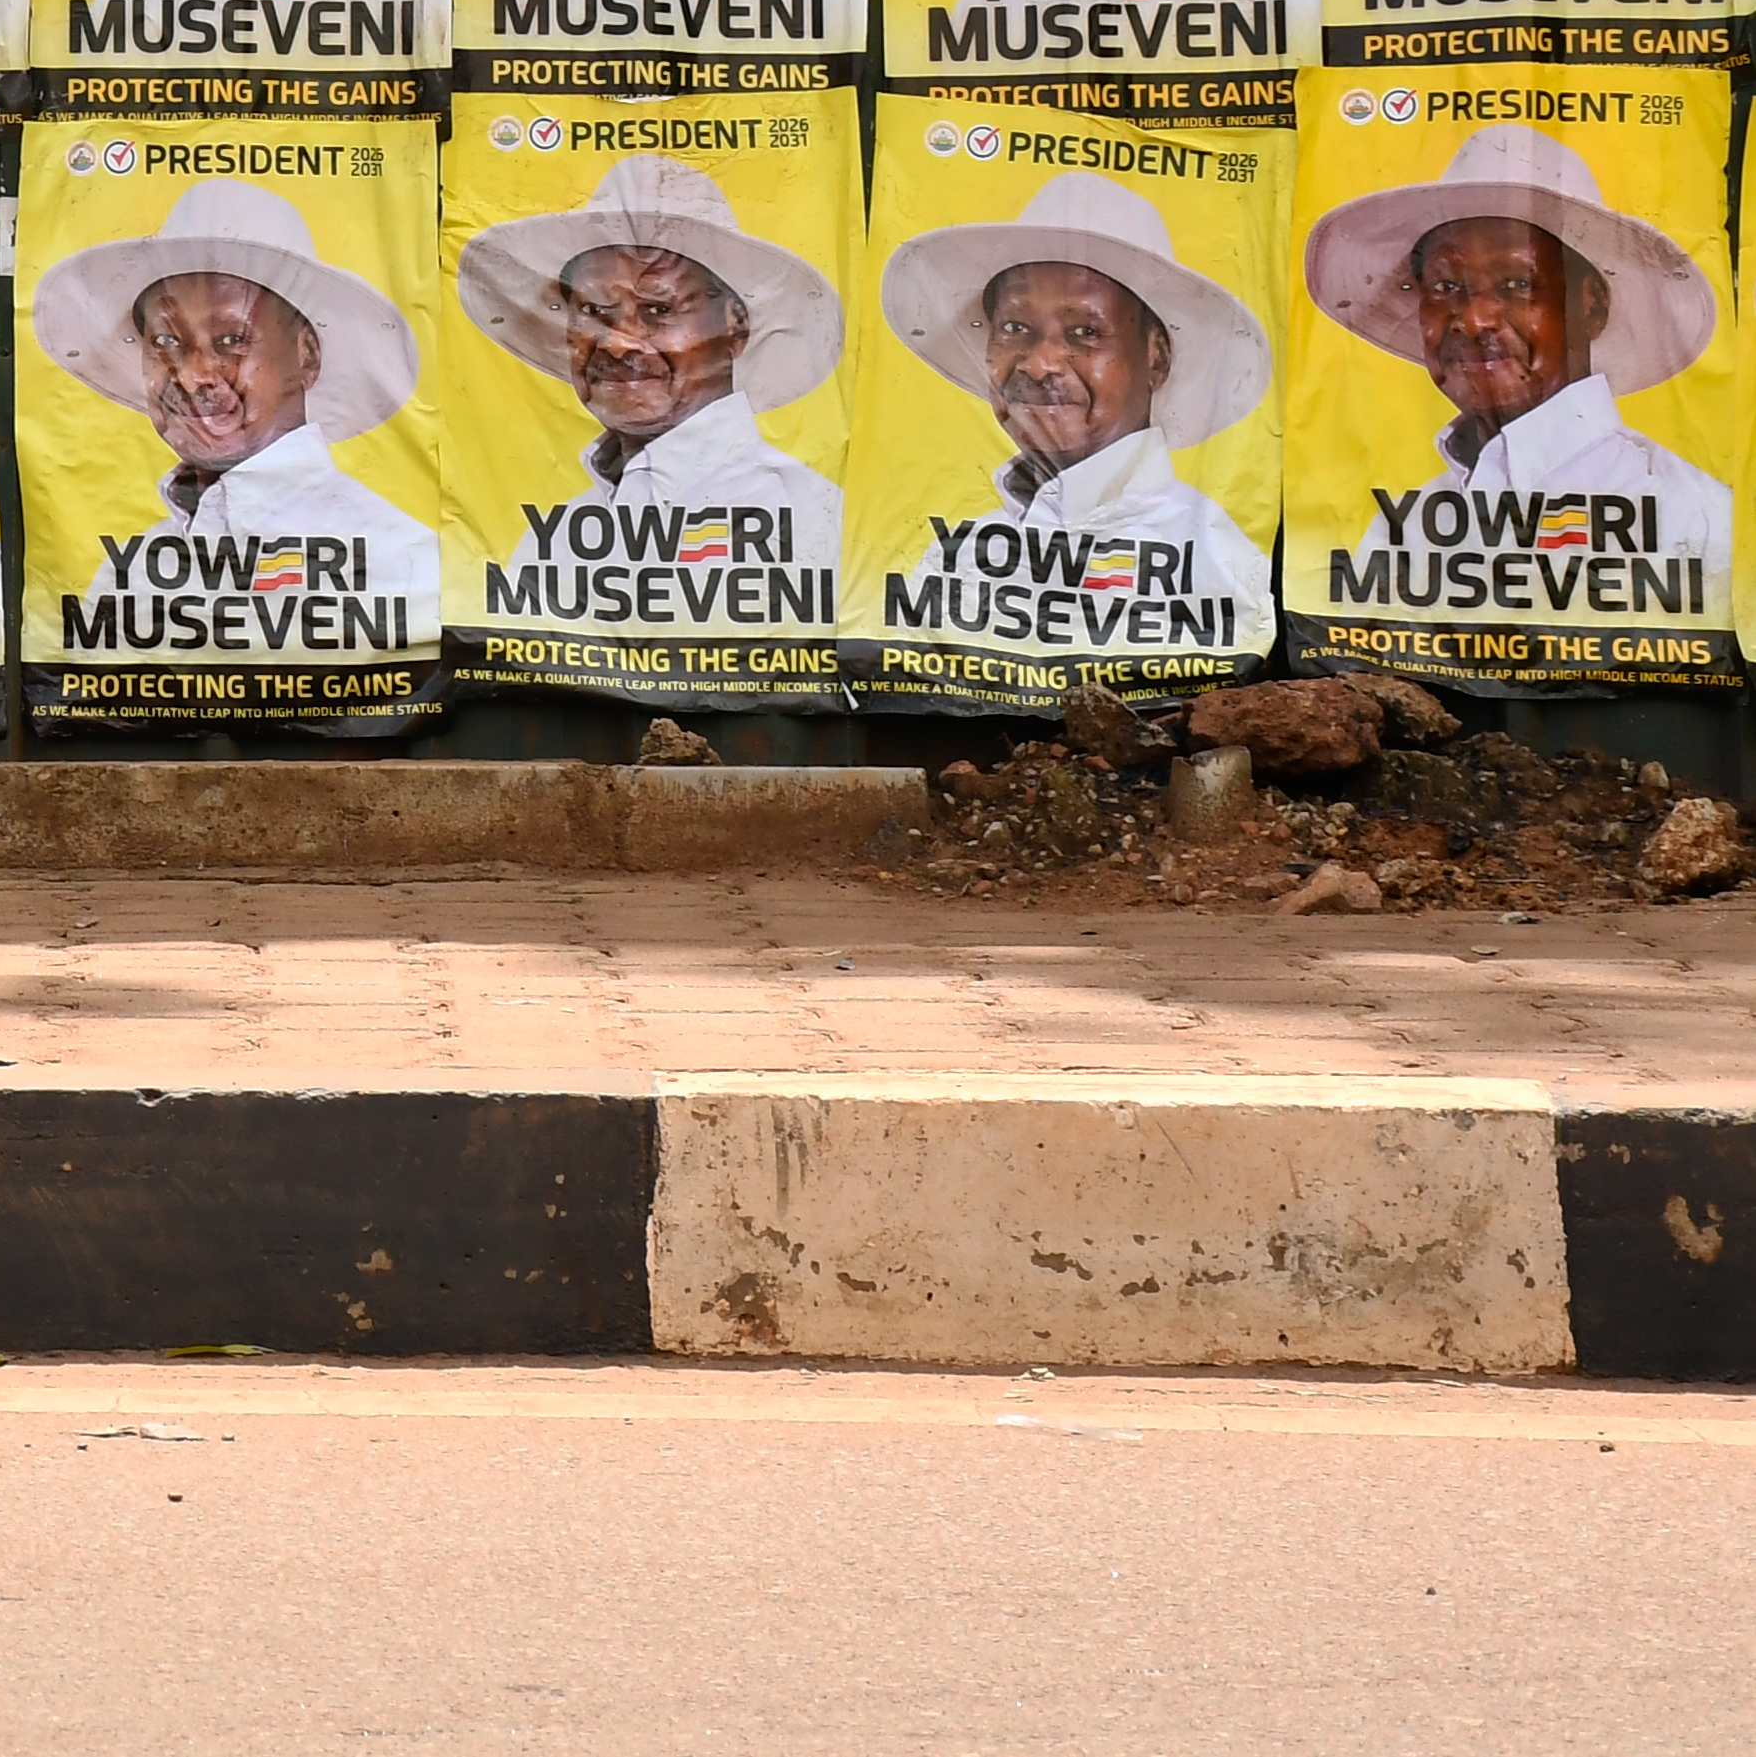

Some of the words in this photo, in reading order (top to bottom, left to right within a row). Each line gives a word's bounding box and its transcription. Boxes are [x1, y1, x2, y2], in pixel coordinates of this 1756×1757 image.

[70, 0, 413, 55] MUSEVENI
[929, 0, 1286, 61] MUSEVENI
[68, 79, 245, 103] PROTECTING
[261, 80, 319, 104] THE
[329, 81, 415, 105] GAINS
[1428, 90, 1633, 122] PRESIDENT
[572, 119, 762, 150] PRESIDENT
[1009, 132, 1213, 178] PRESIDENT
[146, 144, 344, 175] PRESIDENT
[487, 563, 833, 623] MUSEVENI
[1331, 550, 1703, 613] MUSEVENI
[62, 595, 408, 650] MUSEVENI
[886, 574, 1234, 646] MUSEVENI
[62, 674, 245, 698] PROTECTING
[254, 675, 313, 698] THE
[323, 672, 411, 698] GAINS
[32, 706, 46, 716] AS
[50, 706, 69, 716] WE
[72, 707, 106, 717] MAKE
[109, 707, 117, 716] A
[120, 707, 196, 718] QUALITATIVE
[200, 708, 230, 718] LEAP
[234, 708, 262, 718] INTO
[265, 708, 294, 717] HIGH
[298, 707, 344, 716] MIDDLE
[348, 705, 394, 716] INCOME
[397, 703, 442, 715] STATUS
